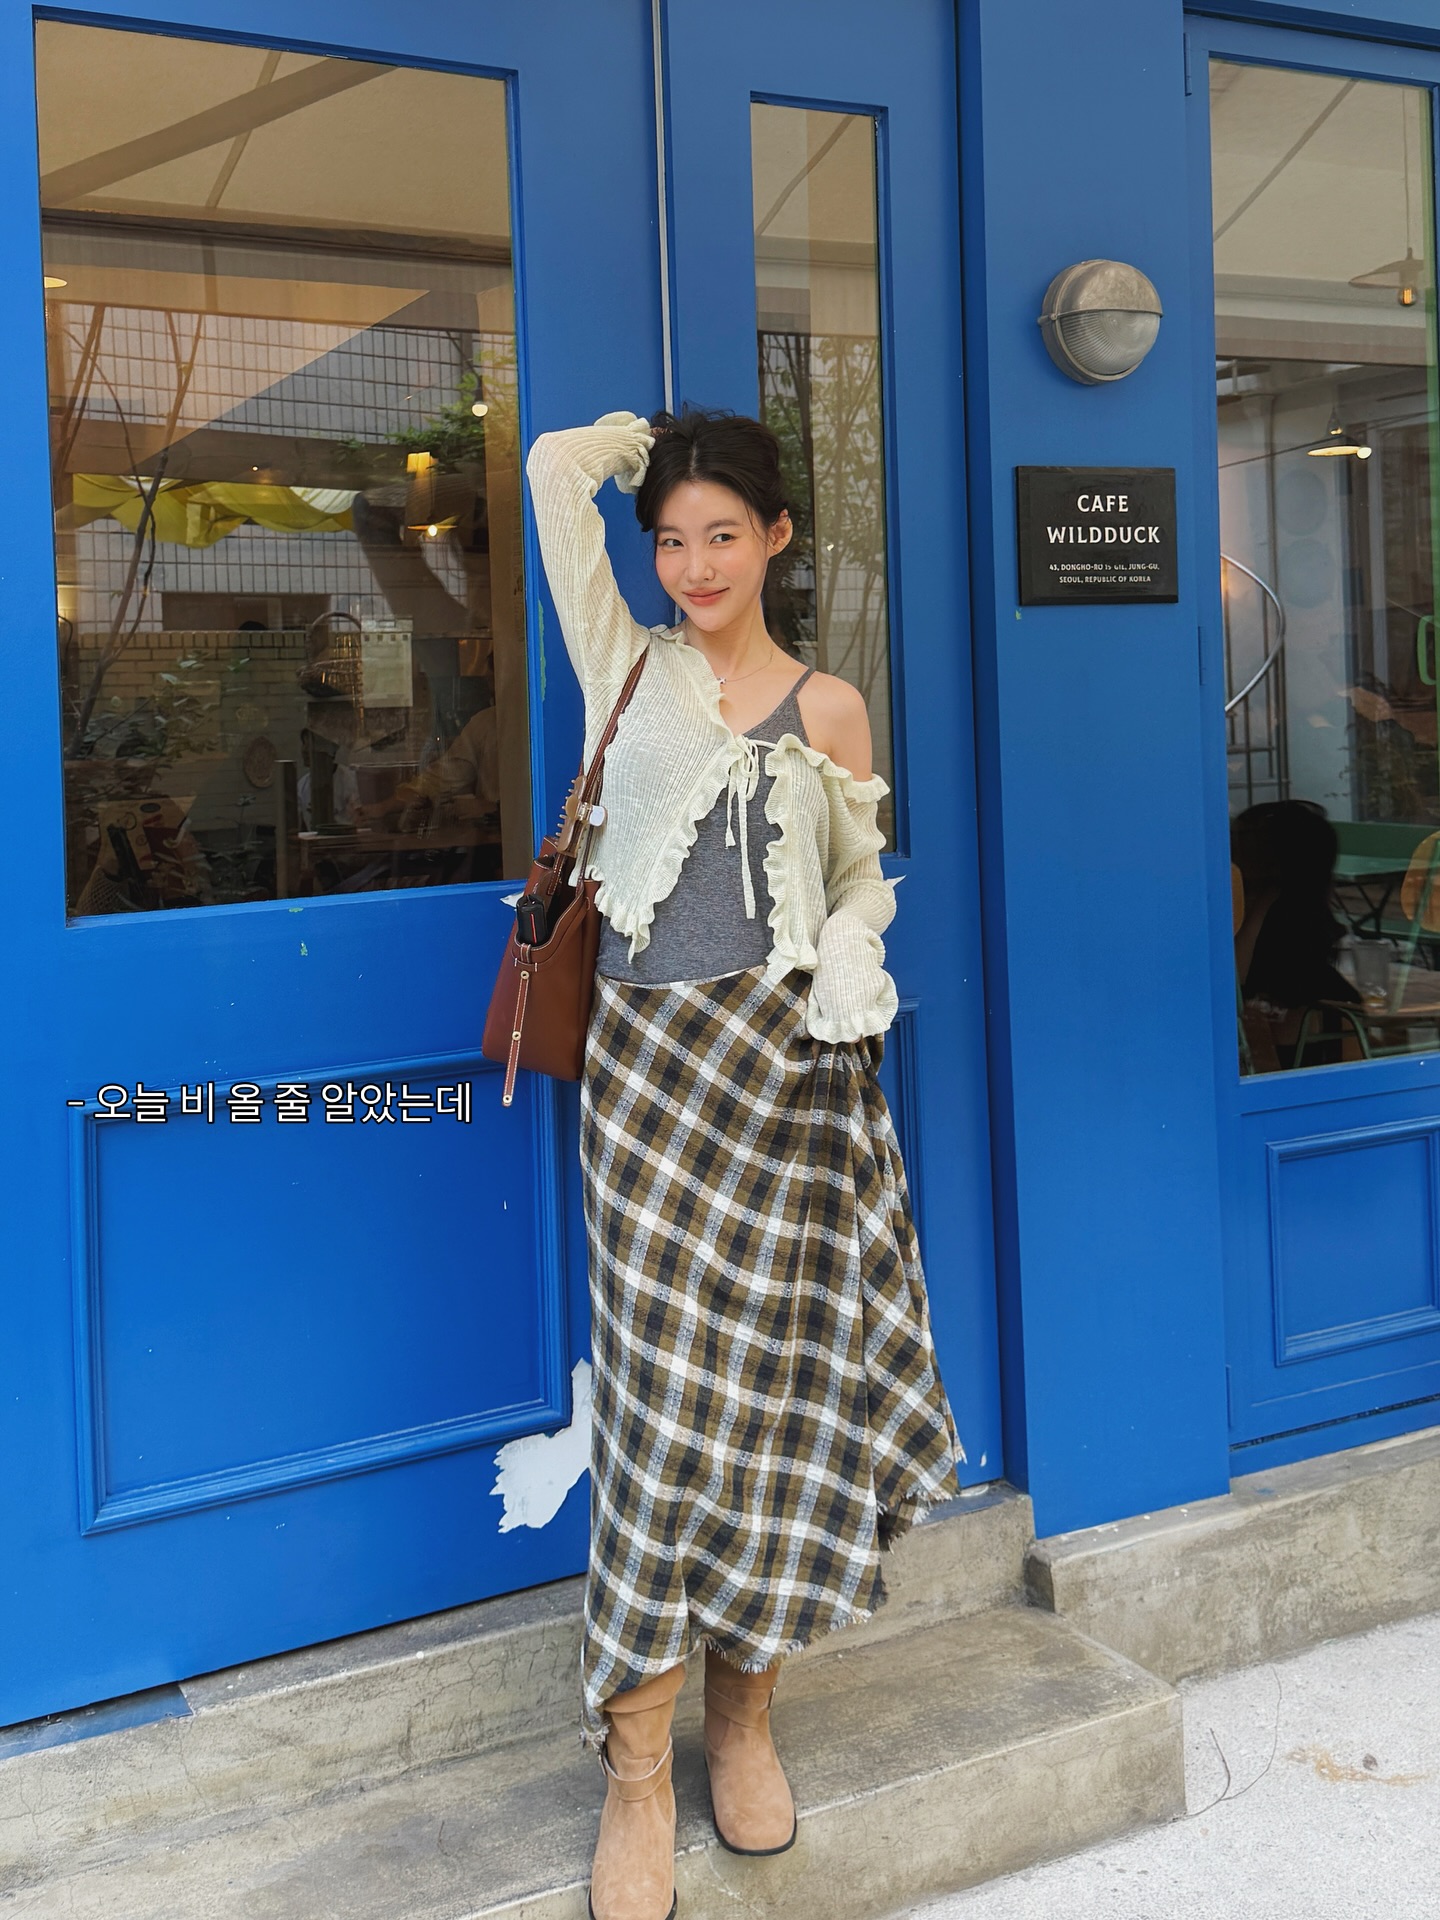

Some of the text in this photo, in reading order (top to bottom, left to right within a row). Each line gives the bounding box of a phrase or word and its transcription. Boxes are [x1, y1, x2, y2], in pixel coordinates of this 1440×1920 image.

[1077, 494, 1129, 513] CAFE
[1046, 526, 1161, 544] WILDDUCK
[1060, 563, 1104, 571] DONGHO-RO
[1084, 575, 1117, 583] REPUBLIC
[1117, 575, 1127, 583] OF
[1128, 574, 1152, 583] KOREA
